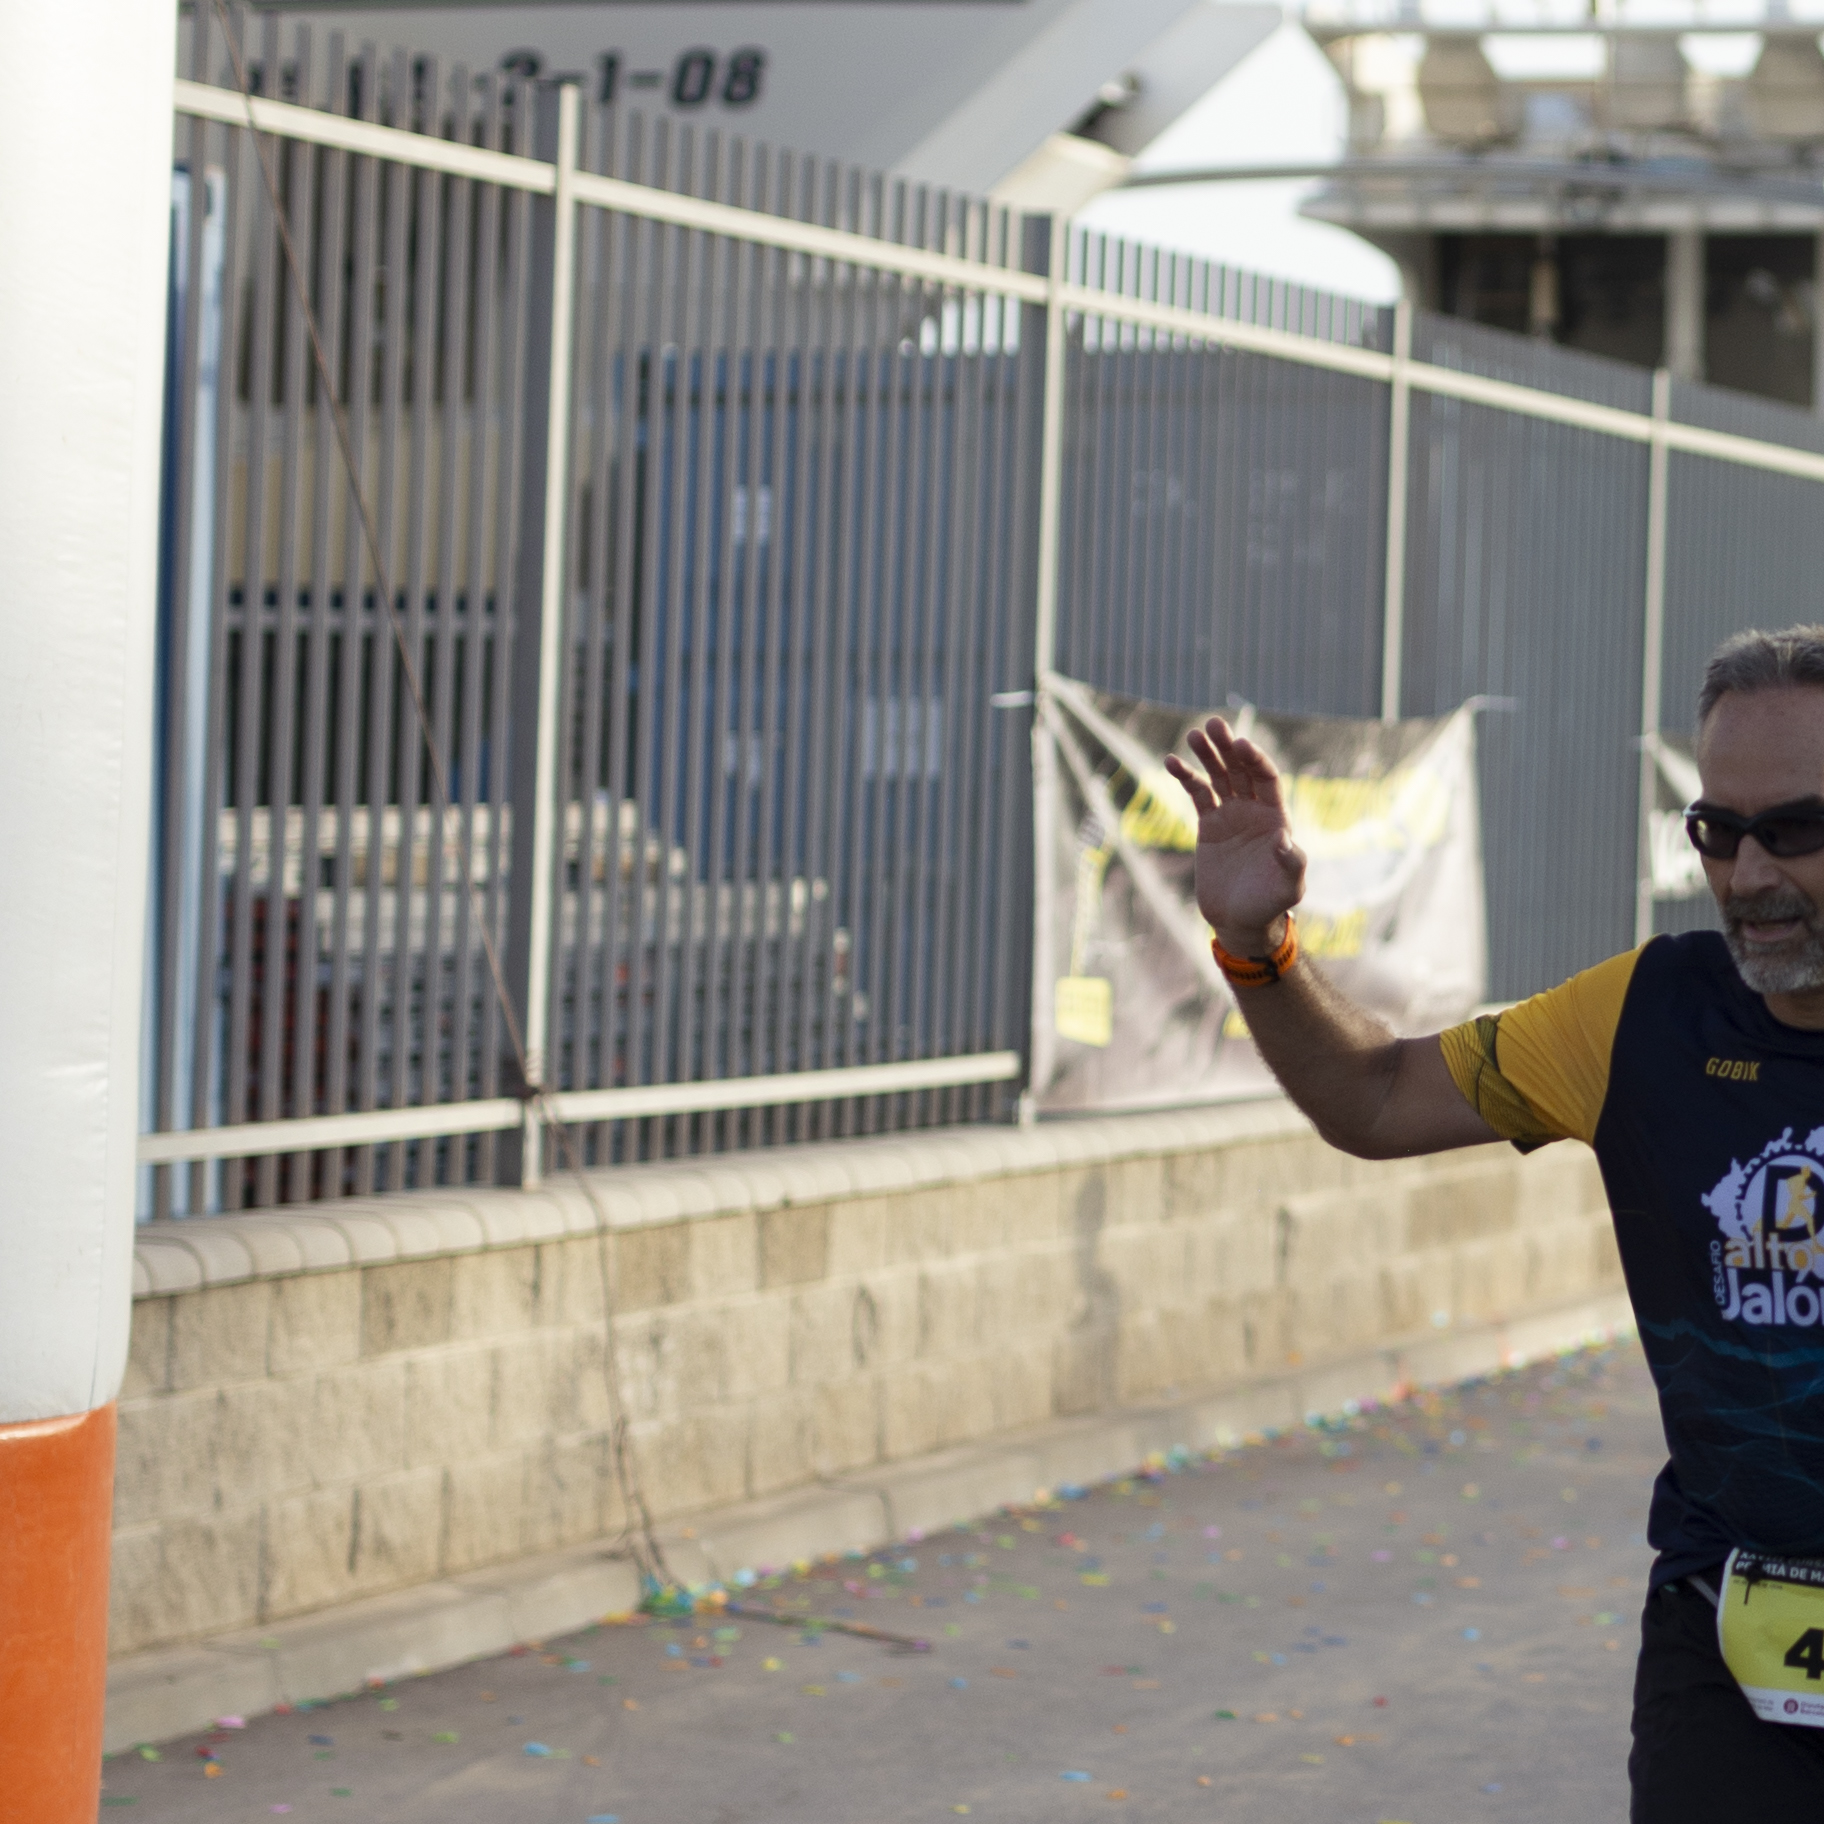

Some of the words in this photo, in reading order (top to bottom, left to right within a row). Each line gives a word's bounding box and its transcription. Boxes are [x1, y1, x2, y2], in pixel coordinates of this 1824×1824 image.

[1705, 1056, 1761, 1082] GOBIK
[1724, 1230, 1815, 1272] alto
[1789, 1566, 1808, 1581] DE
